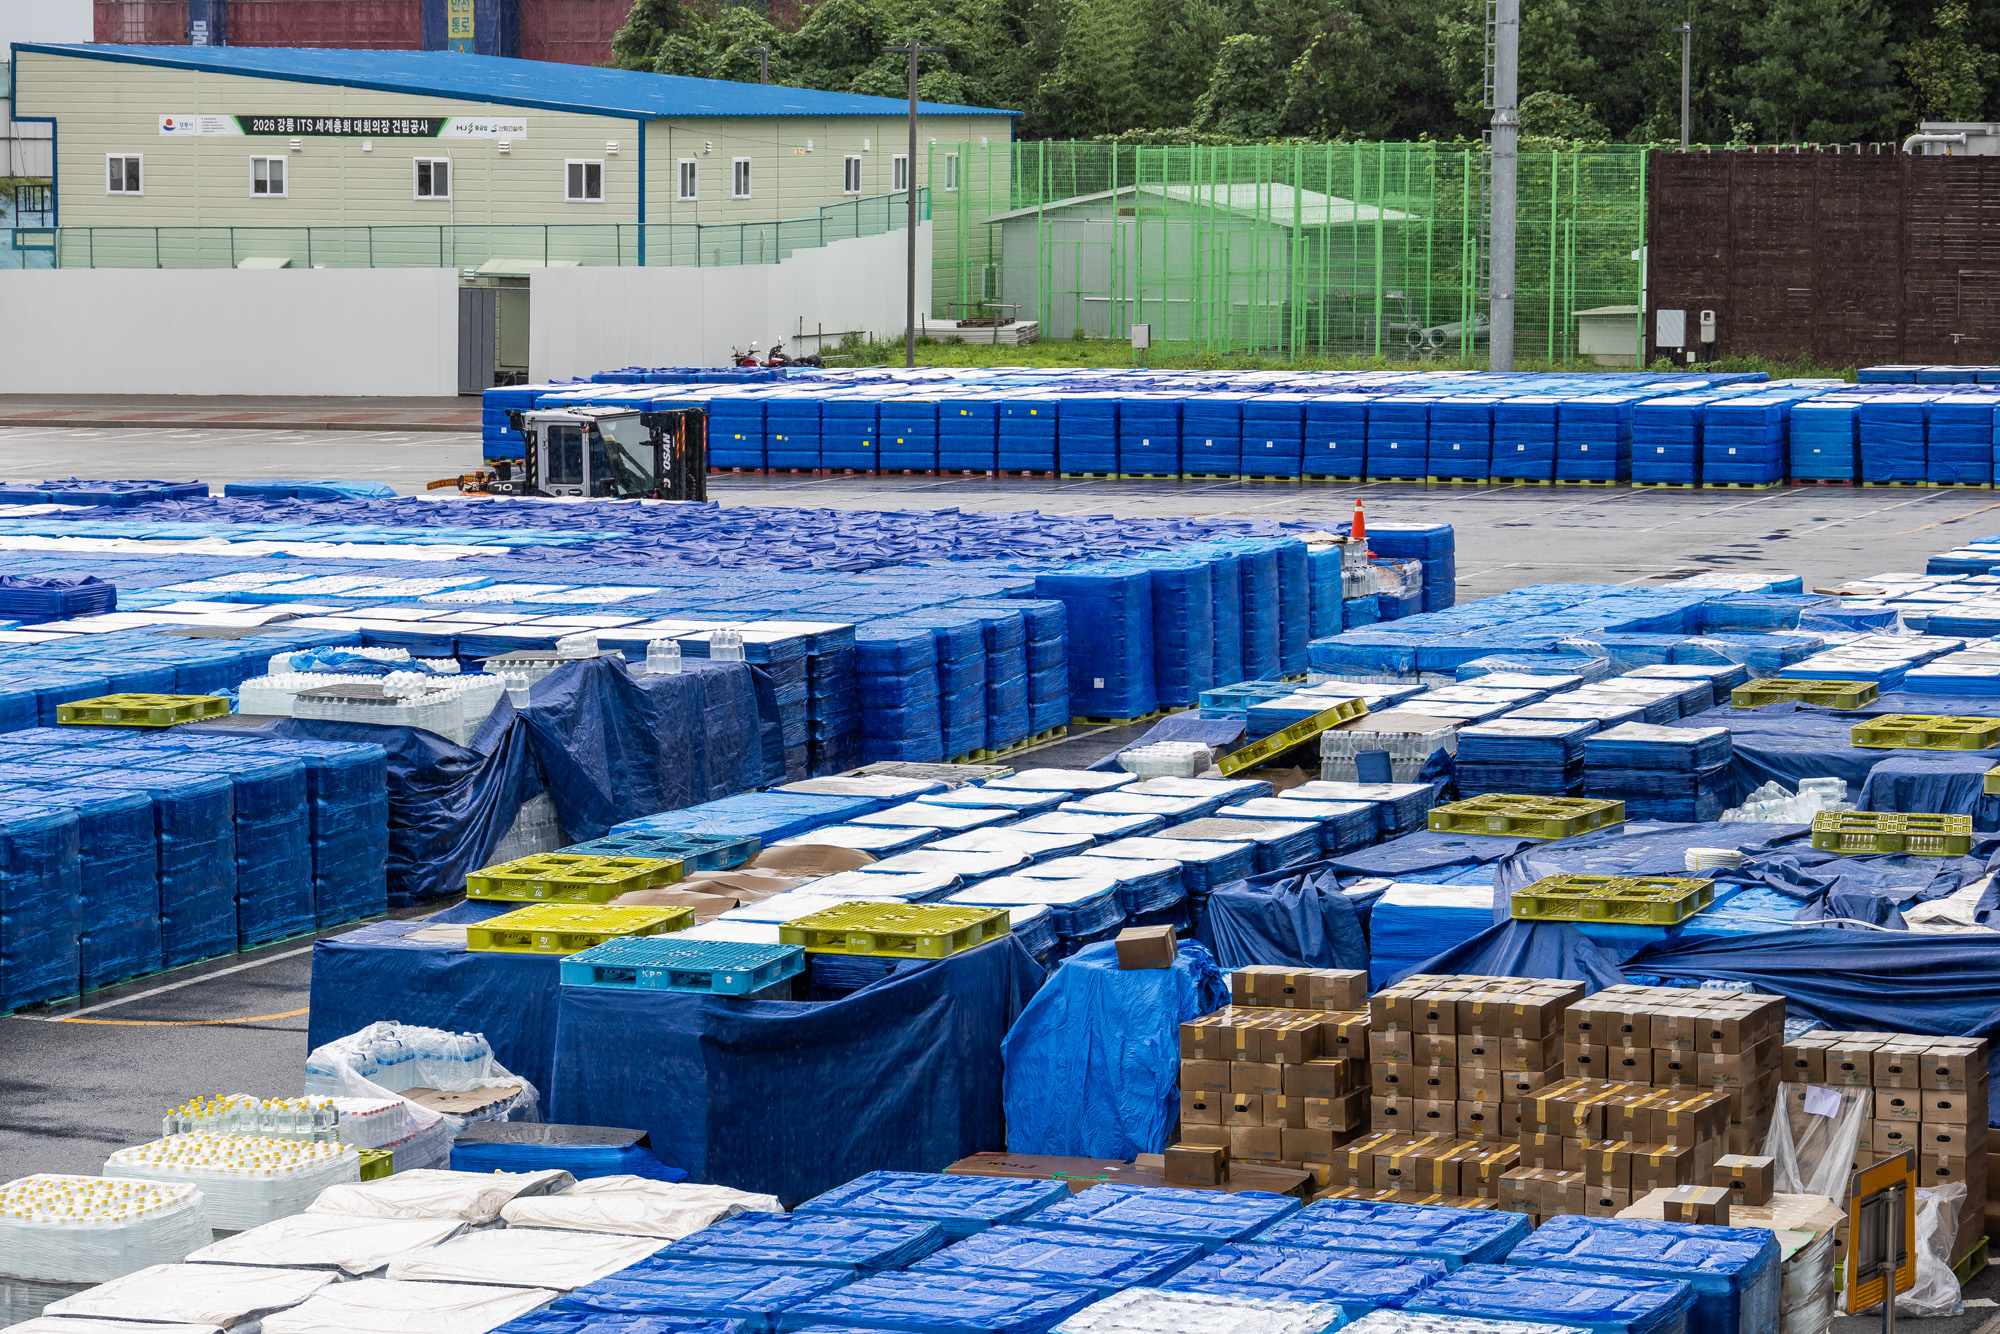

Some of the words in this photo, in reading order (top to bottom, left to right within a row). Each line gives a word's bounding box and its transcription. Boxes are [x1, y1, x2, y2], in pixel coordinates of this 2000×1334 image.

[451, 16, 470, 34] 통로
[253, 118, 275, 131] 2026
[277, 118, 295, 132] 강릉
[297, 118, 313, 132] ITS
[315, 118, 351, 134] 세계총회
[353, 119, 390, 134] 대회의장
[392, 120, 429, 134] 건립공사
[663, 432, 671, 489] DOSAN
